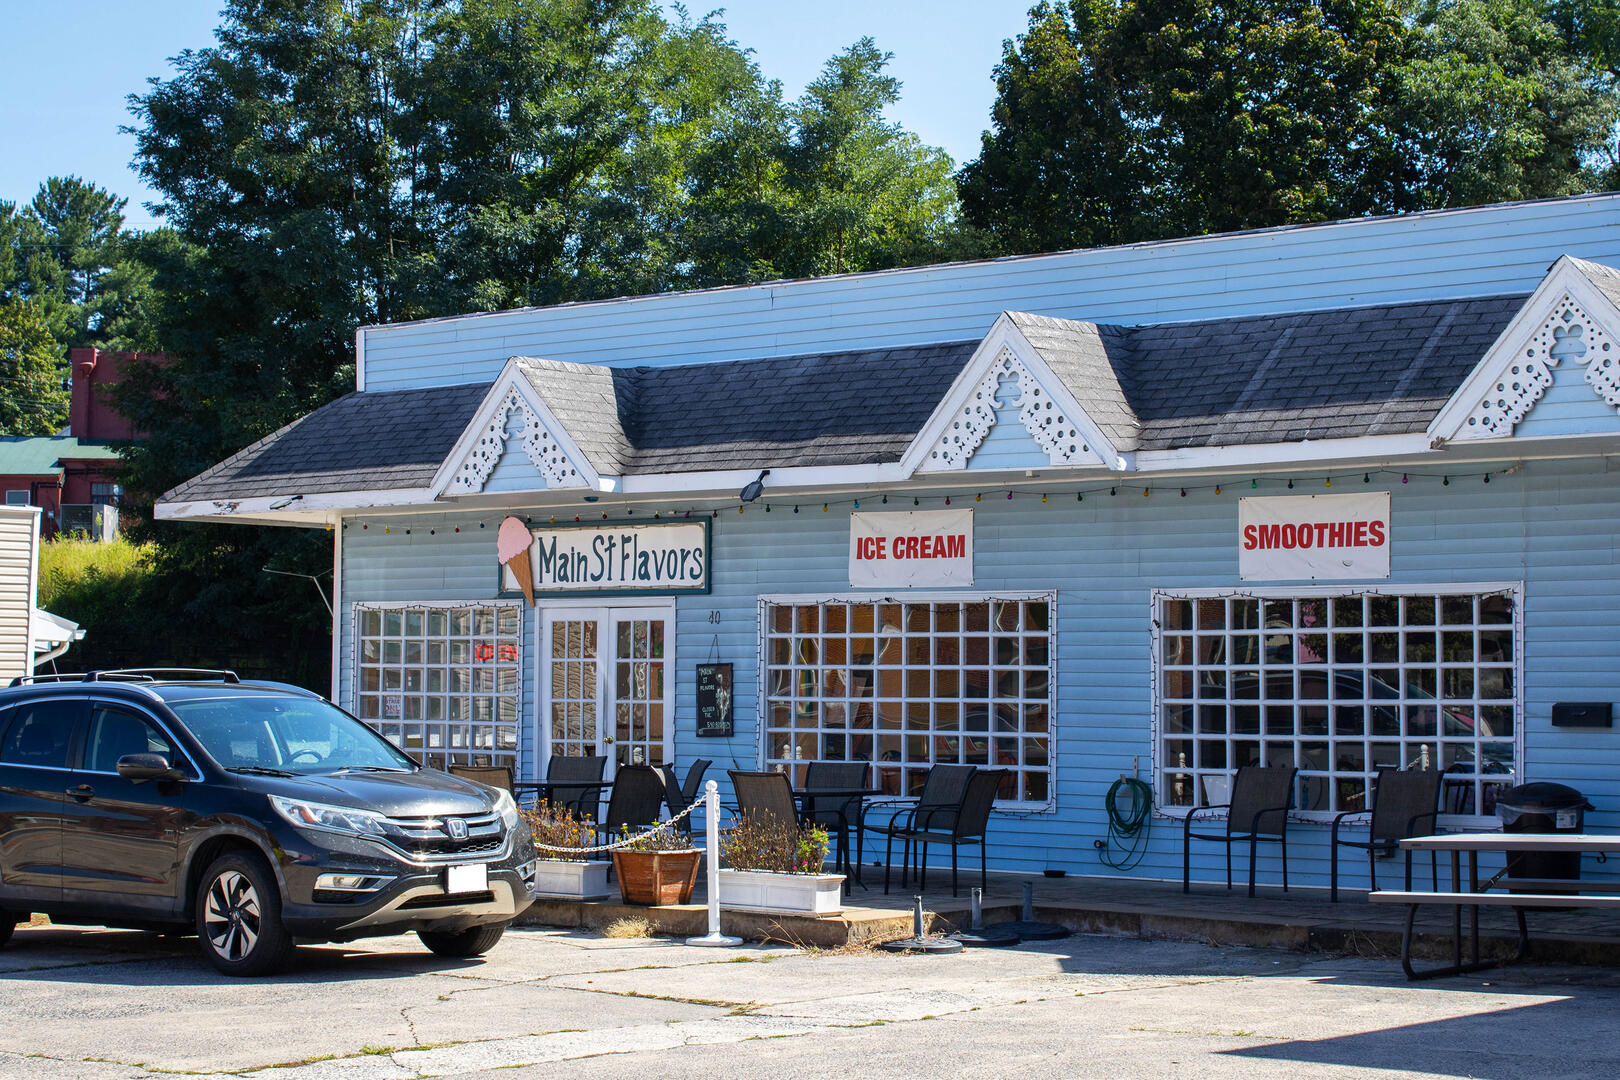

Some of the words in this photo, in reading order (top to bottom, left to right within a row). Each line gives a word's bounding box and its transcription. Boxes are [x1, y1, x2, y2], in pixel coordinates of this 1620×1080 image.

[856, 536, 887, 560] ICE
[892, 534, 966, 560] CREAM
[1243, 520, 1386, 551] SMOOTHIES
[538, 535, 588, 584] Main
[590, 534, 617, 582] St
[620, 533, 703, 581] Flavors
[708, 611, 720, 624] 40
[477, 645, 518, 660] OPEN
